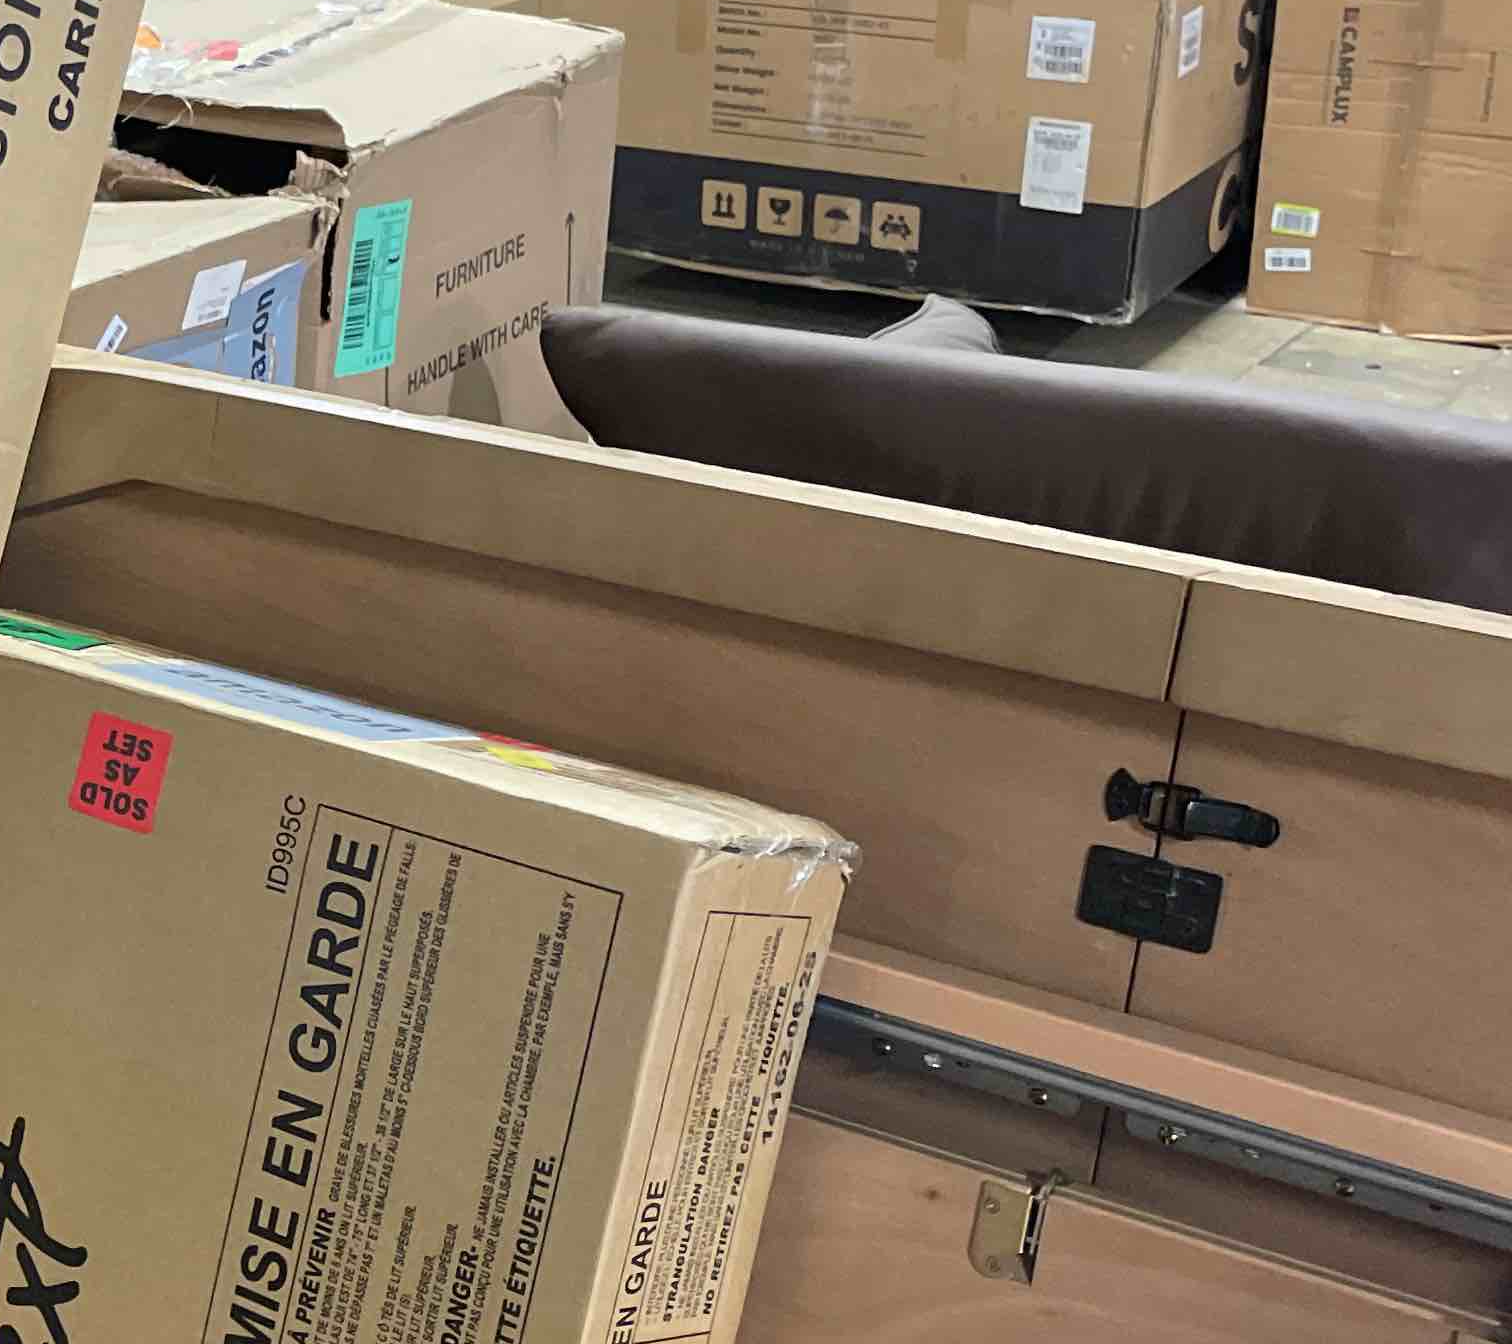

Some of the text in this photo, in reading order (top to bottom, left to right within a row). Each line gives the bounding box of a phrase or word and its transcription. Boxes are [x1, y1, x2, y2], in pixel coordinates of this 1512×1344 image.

[1330, 25, 1358, 124] CAMPLUX
[435, 233, 526, 300] FURNITURE
[407, 300, 551, 395] HANDLE WITH CARE
[102, 729, 153, 762] SET
[103, 759, 141, 787] AS
[80, 781, 149, 821] SOLD
[265, 794, 308, 896] ID995C
[283, 831, 382, 1080] GARDE
[260, 1087, 324, 1189] EN
[735, 1094, 763, 1154] CETTE
[655, 1106, 724, 1322] STRANGULATION DANGER
[726, 1161, 746, 1196] PAS
[290, 1202, 337, 1326] PRÉVENIR
[621, 1177, 673, 1280] GARDE
[704, 1203, 739, 1281] RETIREZ
